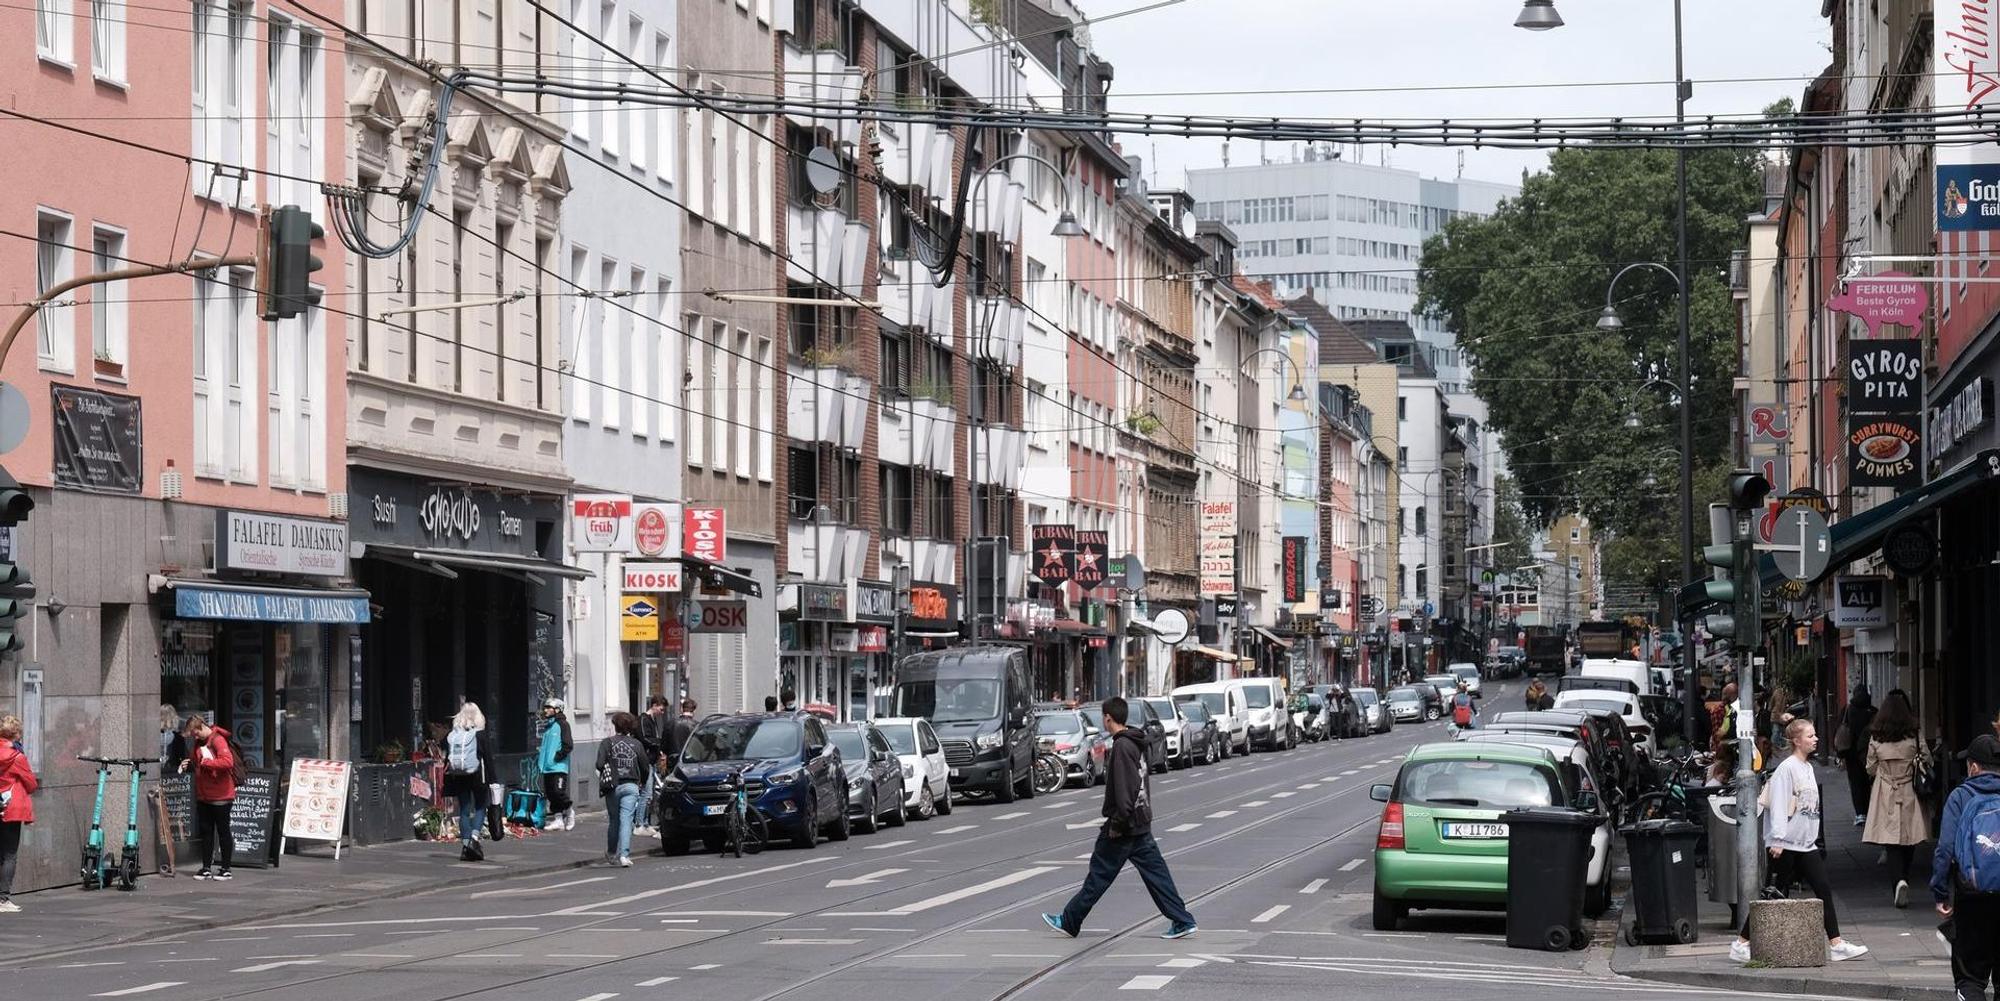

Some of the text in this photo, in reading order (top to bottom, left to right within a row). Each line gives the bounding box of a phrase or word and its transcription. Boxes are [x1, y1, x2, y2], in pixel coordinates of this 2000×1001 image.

[1856, 285, 1916, 294] FERKULUM
[1857, 297, 1916, 307] Beste Gyros
[1869, 307, 1904, 316] in Köln
[1851, 350, 1920, 380] GYROS
[1865, 382, 1908, 398] PITA
[1851, 422, 1920, 446] CURRYWURST
[1856, 458, 1914, 478] POMMES
[374, 494, 397, 523] Sushi
[1202, 502, 1232, 514] Falafel
[501, 510, 522, 536] Ramen
[590, 520, 613, 534] früh
[234, 518, 343, 552] FALAFEL DAMASKUS
[692, 510, 718, 560] KIOSK
[1033, 526, 1074, 540] CUBANA
[1039, 568, 1069, 578] BAR
[1075, 572, 1102, 581] BAR
[626, 574, 678, 588] KIOSK
[1848, 592, 1874, 605] ALI
[200, 592, 260, 619] SHAWARMA
[310, 598, 356, 622] DAMASKUS
[1218, 602, 1234, 613] sky
[702, 606, 746, 626] OSK
[160, 655, 210, 676] SHAWARMA
[1455, 825, 1462, 836] K
